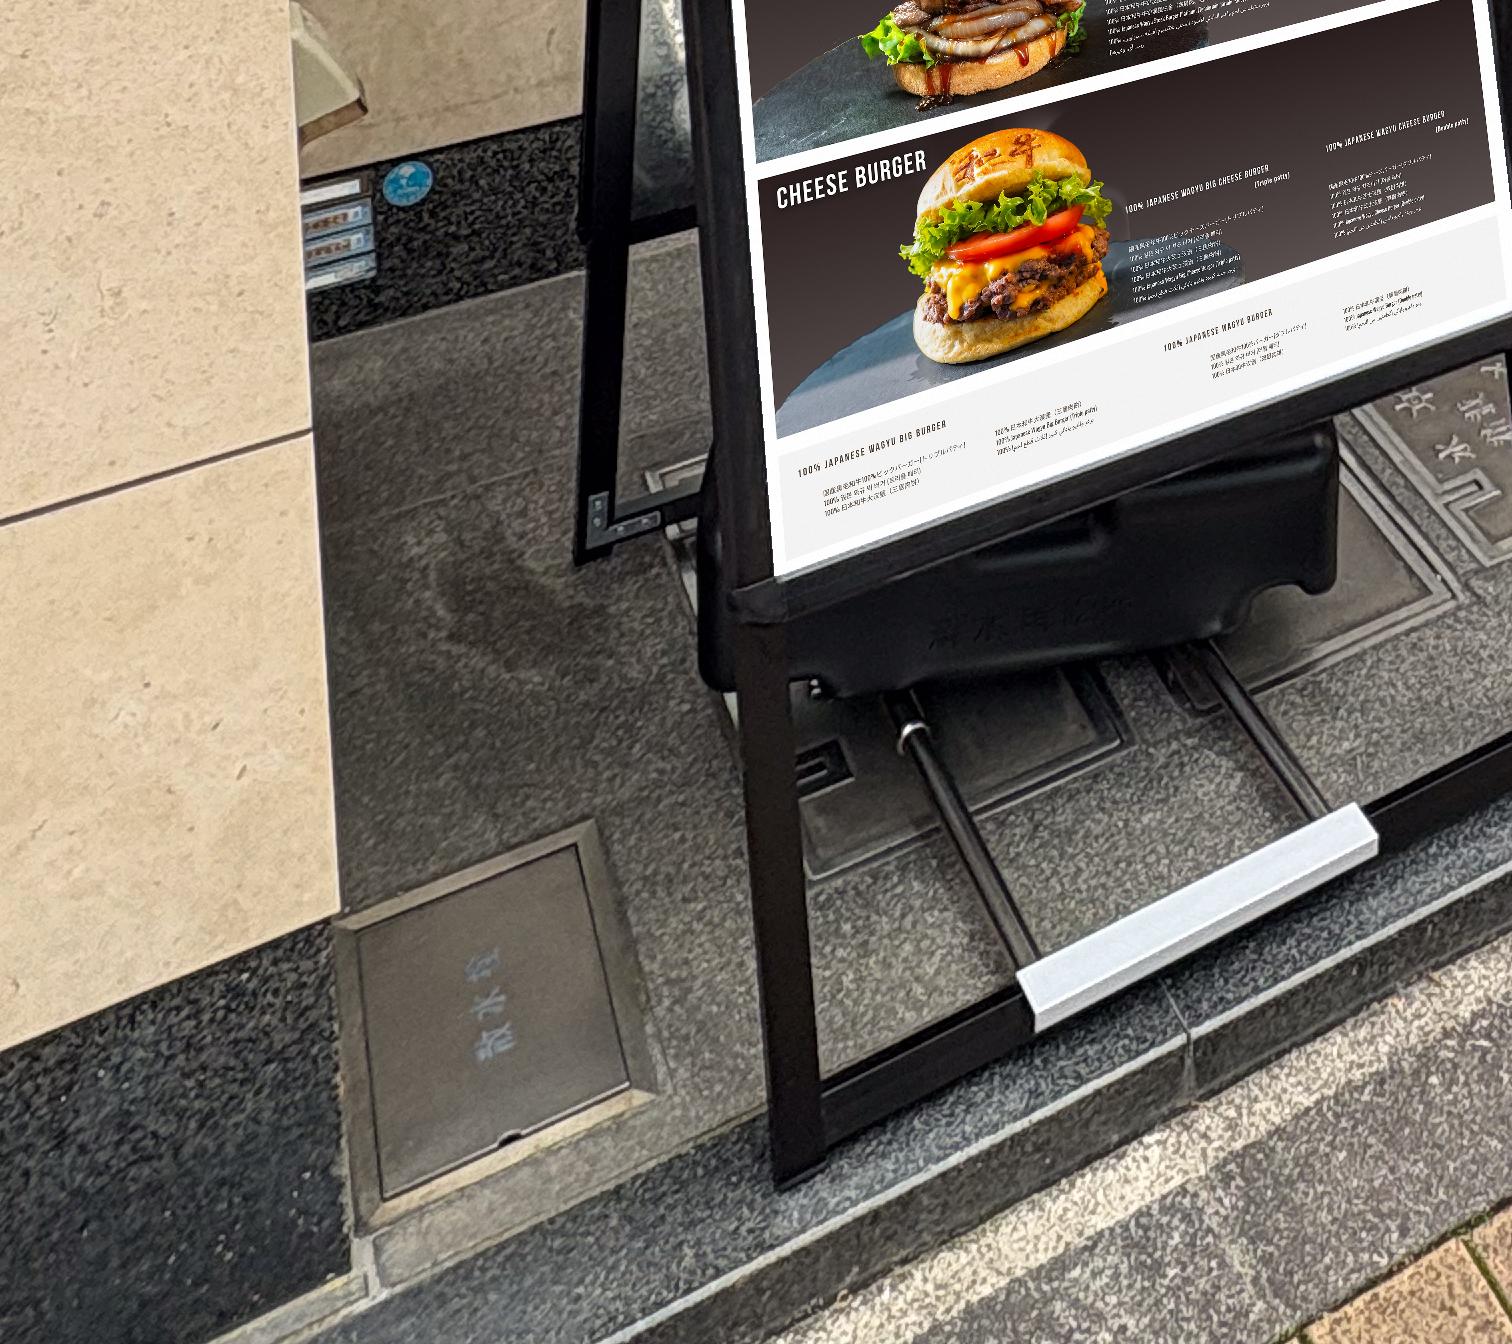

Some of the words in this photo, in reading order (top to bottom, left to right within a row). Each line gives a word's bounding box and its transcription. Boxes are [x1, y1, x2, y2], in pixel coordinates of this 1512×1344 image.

[775, 169, 849, 210] CHEESE
[854, 148, 927, 188] BURGER
[1145, 190, 1179, 208] JAPANESE
[1218, 171, 1242, 186] CHEESE
[1244, 163, 1269, 179] BURGER
[798, 462, 820, 477] 100%
[824, 447, 865, 468] JAPANESE
[868, 436, 896, 453] WAGYU
[899, 431, 912, 443] BIG
[915, 419, 946, 437] BURGER
